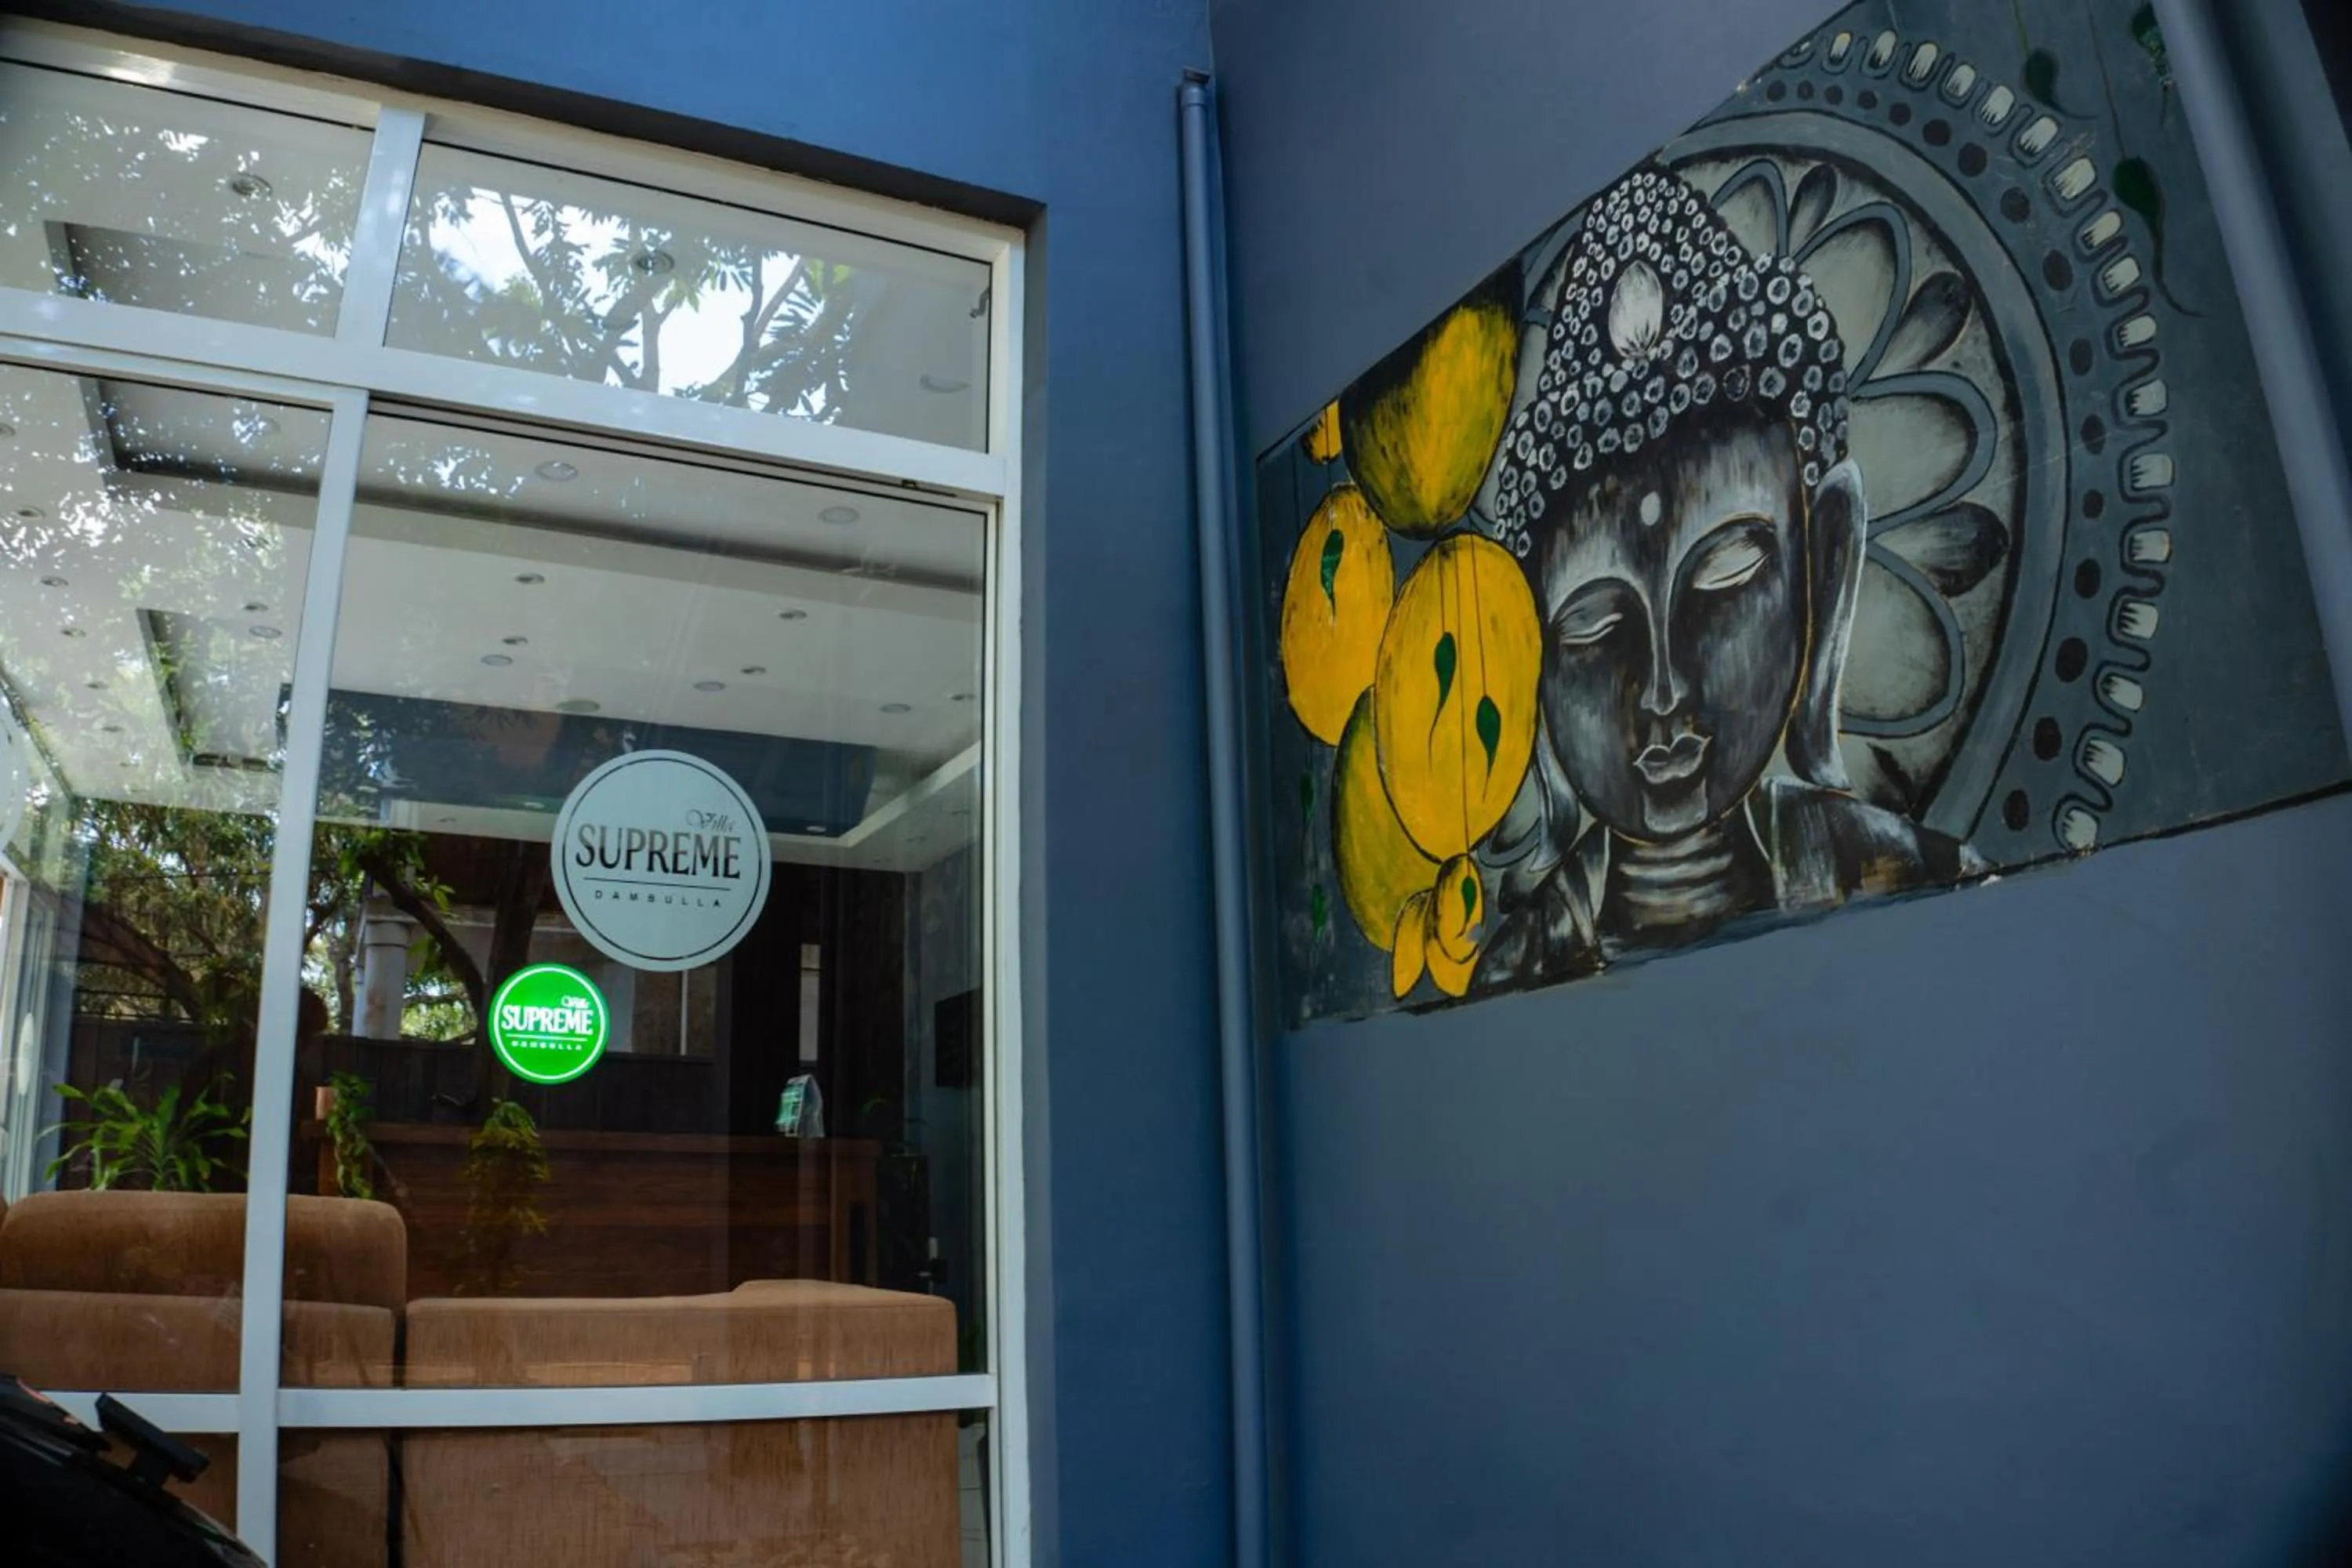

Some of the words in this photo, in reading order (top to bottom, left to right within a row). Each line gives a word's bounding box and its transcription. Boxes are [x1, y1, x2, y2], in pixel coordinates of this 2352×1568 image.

[575, 823, 741, 879] SUPREME
[594, 890, 721, 907] DAMBULLA
[501, 1004, 593, 1035] SUPREME
